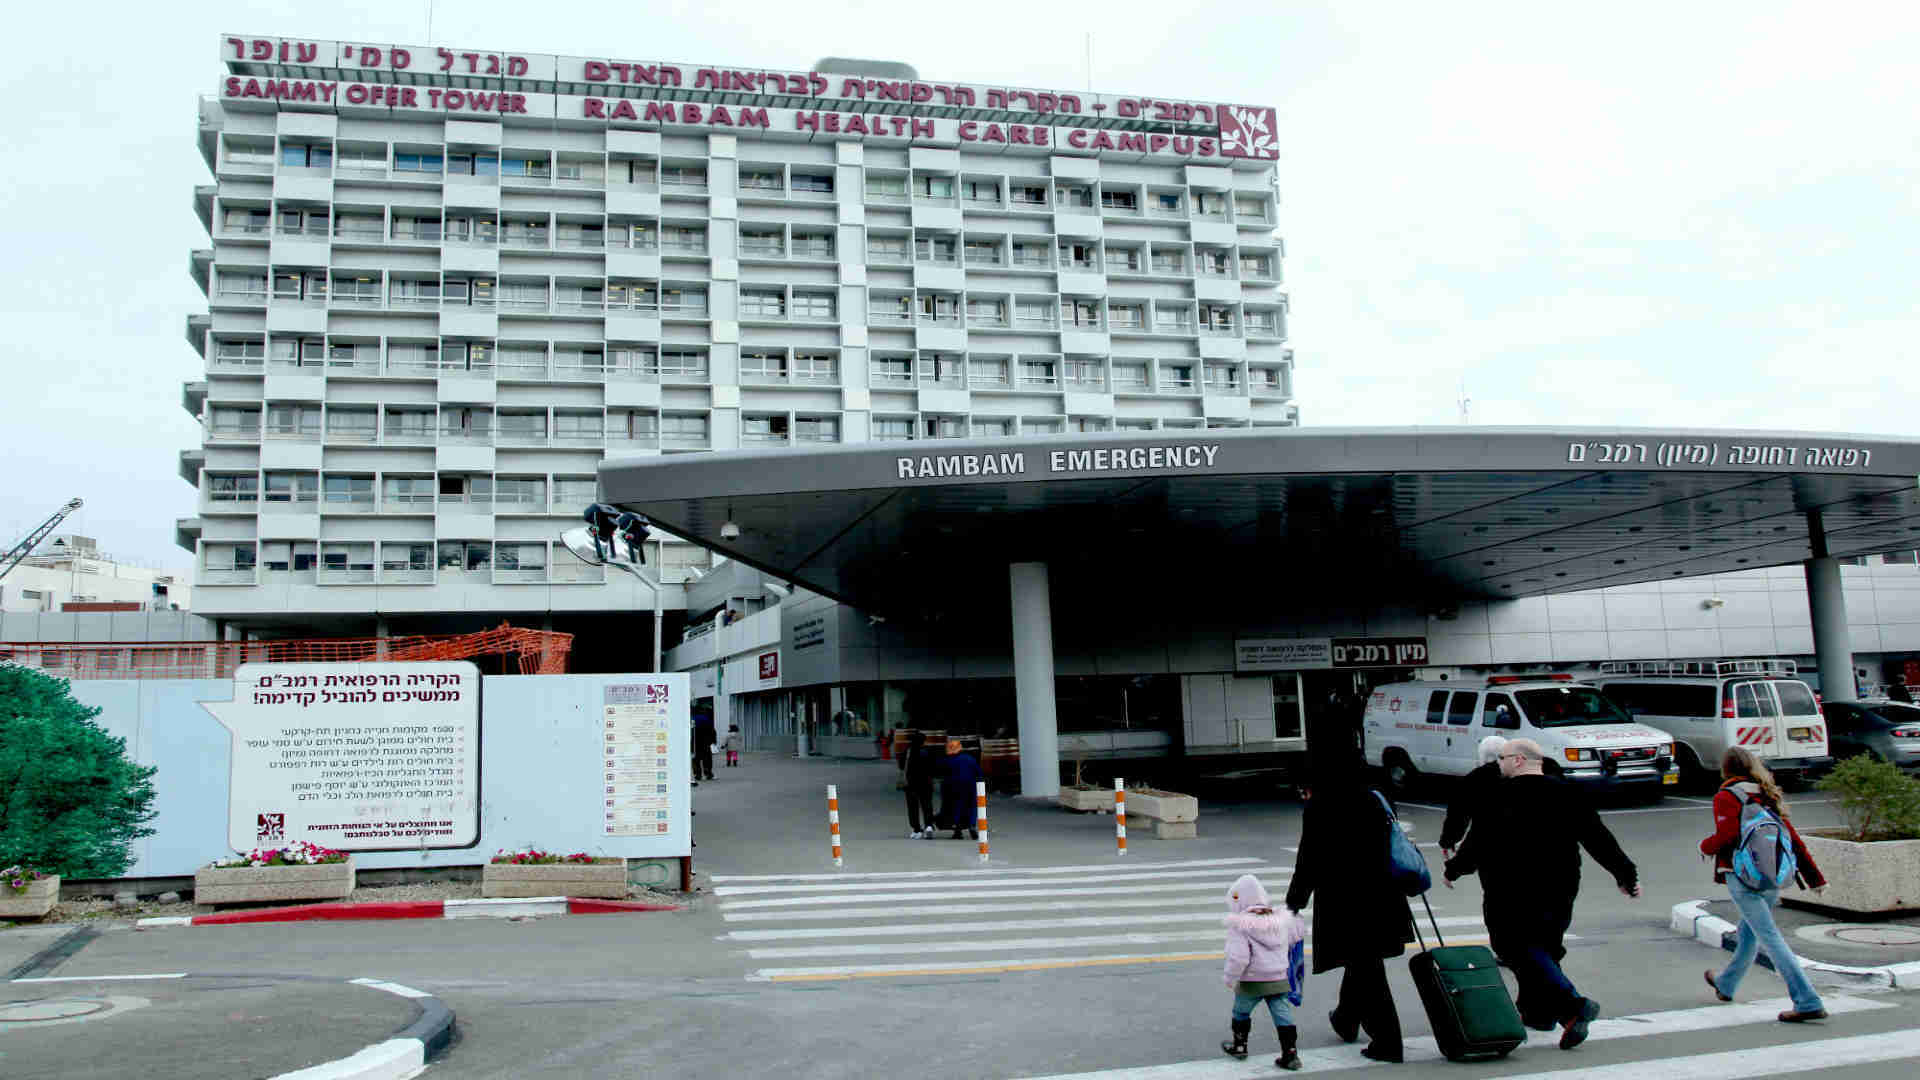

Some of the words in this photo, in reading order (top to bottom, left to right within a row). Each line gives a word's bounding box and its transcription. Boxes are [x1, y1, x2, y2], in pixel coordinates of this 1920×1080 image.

[228, 38, 317, 63] עופר
[345, 45, 411, 69] סמי
[438, 47, 528, 77] מגדל
[584, 61, 682, 86] האדם
[695, 68, 828, 95] לבריאות
[225, 76, 337, 102] SAMMY
[346, 84, 418, 108] OFER
[428, 90, 528, 114] TOWER
[841, 77, 976, 107] הרפואית
[986, 87, 1082, 114] הקריה
[584, 98, 770, 128] RAMBAM
[796, 110, 935, 139] HEALTH
[959, 121, 1048, 145] CARE
[1069, 129, 1217, 157] CAMPUS
[897, 452, 1025, 479] RAMBAM
[1050, 445, 1219, 472] EMERGENCY
[1656, 442, 1719, 467] (מיון)
[1728, 444, 1798, 466] דחופה
[1805, 446, 1872, 468] רפואה
[1395, 644, 1426, 665] מיון
[324, 674, 400, 687] הרפואית
[407, 674, 461, 689] הקריה
[254, 692, 316, 707] קדימה!
[321, 689, 377, 703] להוביל
[383, 690, 460, 703] ממשיכים
[438, 736, 454, 744] בית
[437, 757, 454, 765] בית
